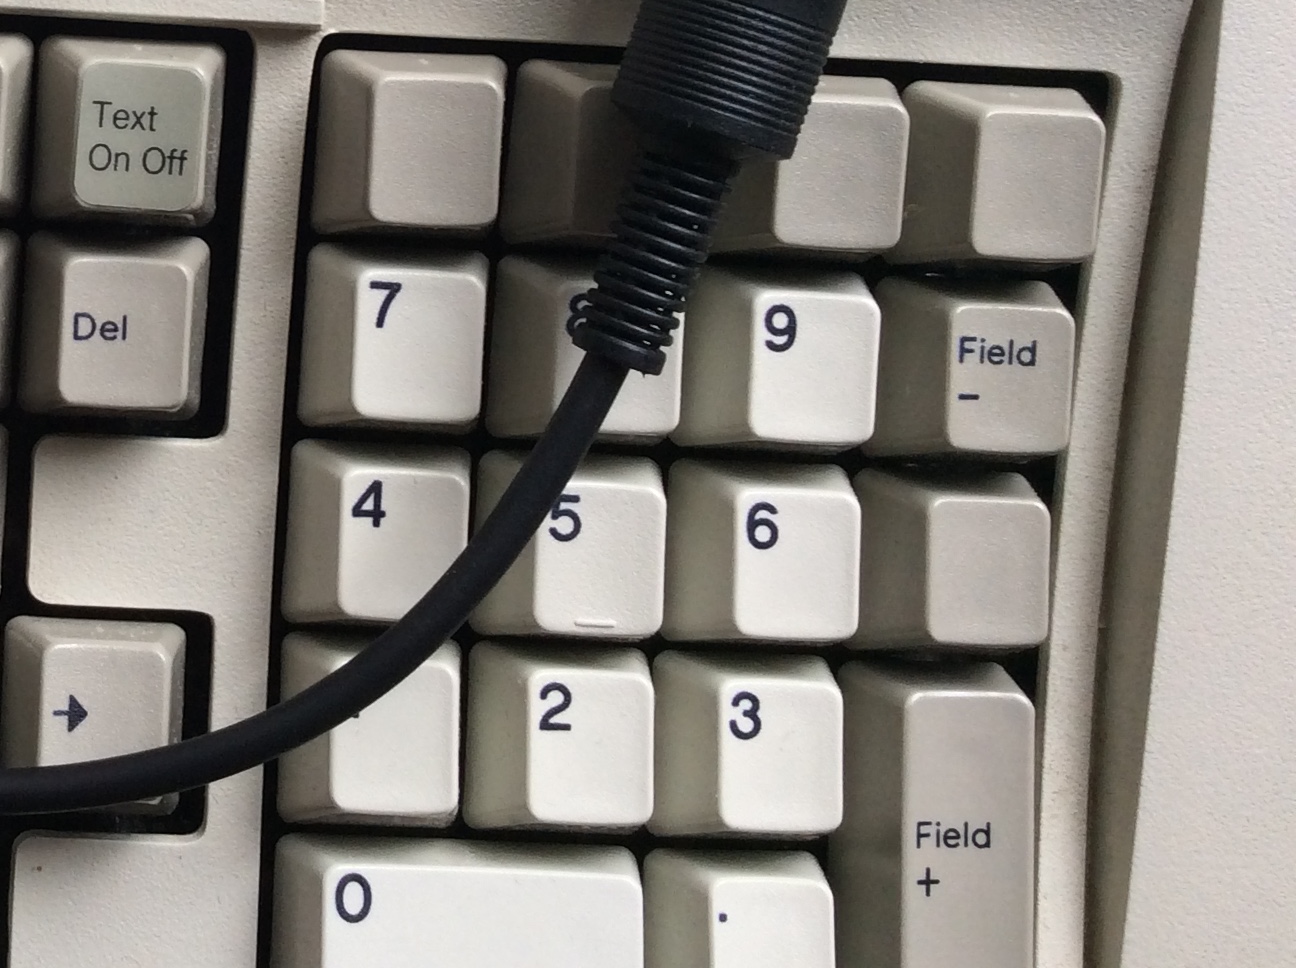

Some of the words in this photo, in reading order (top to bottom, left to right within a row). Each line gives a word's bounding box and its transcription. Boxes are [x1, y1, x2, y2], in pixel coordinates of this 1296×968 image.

[92, 99, 159, 132] Text
[88, 142, 131, 173] On
[142, 146, 189, 177] Off
[71, 311, 129, 342] Del
[368, 280, 402, 329] 7
[763, 303, 798, 353] 9
[958, 335, 1038, 368] Field
[351, 479, 387, 529] 4
[547, 493, 583, 543] 5
[745, 501, 780, 550] 6
[538, 681, 573, 732] 2
[728, 691, 762, 741] 3
[915, 820, 992, 850] Field
[334, 871, 373, 924] 0
